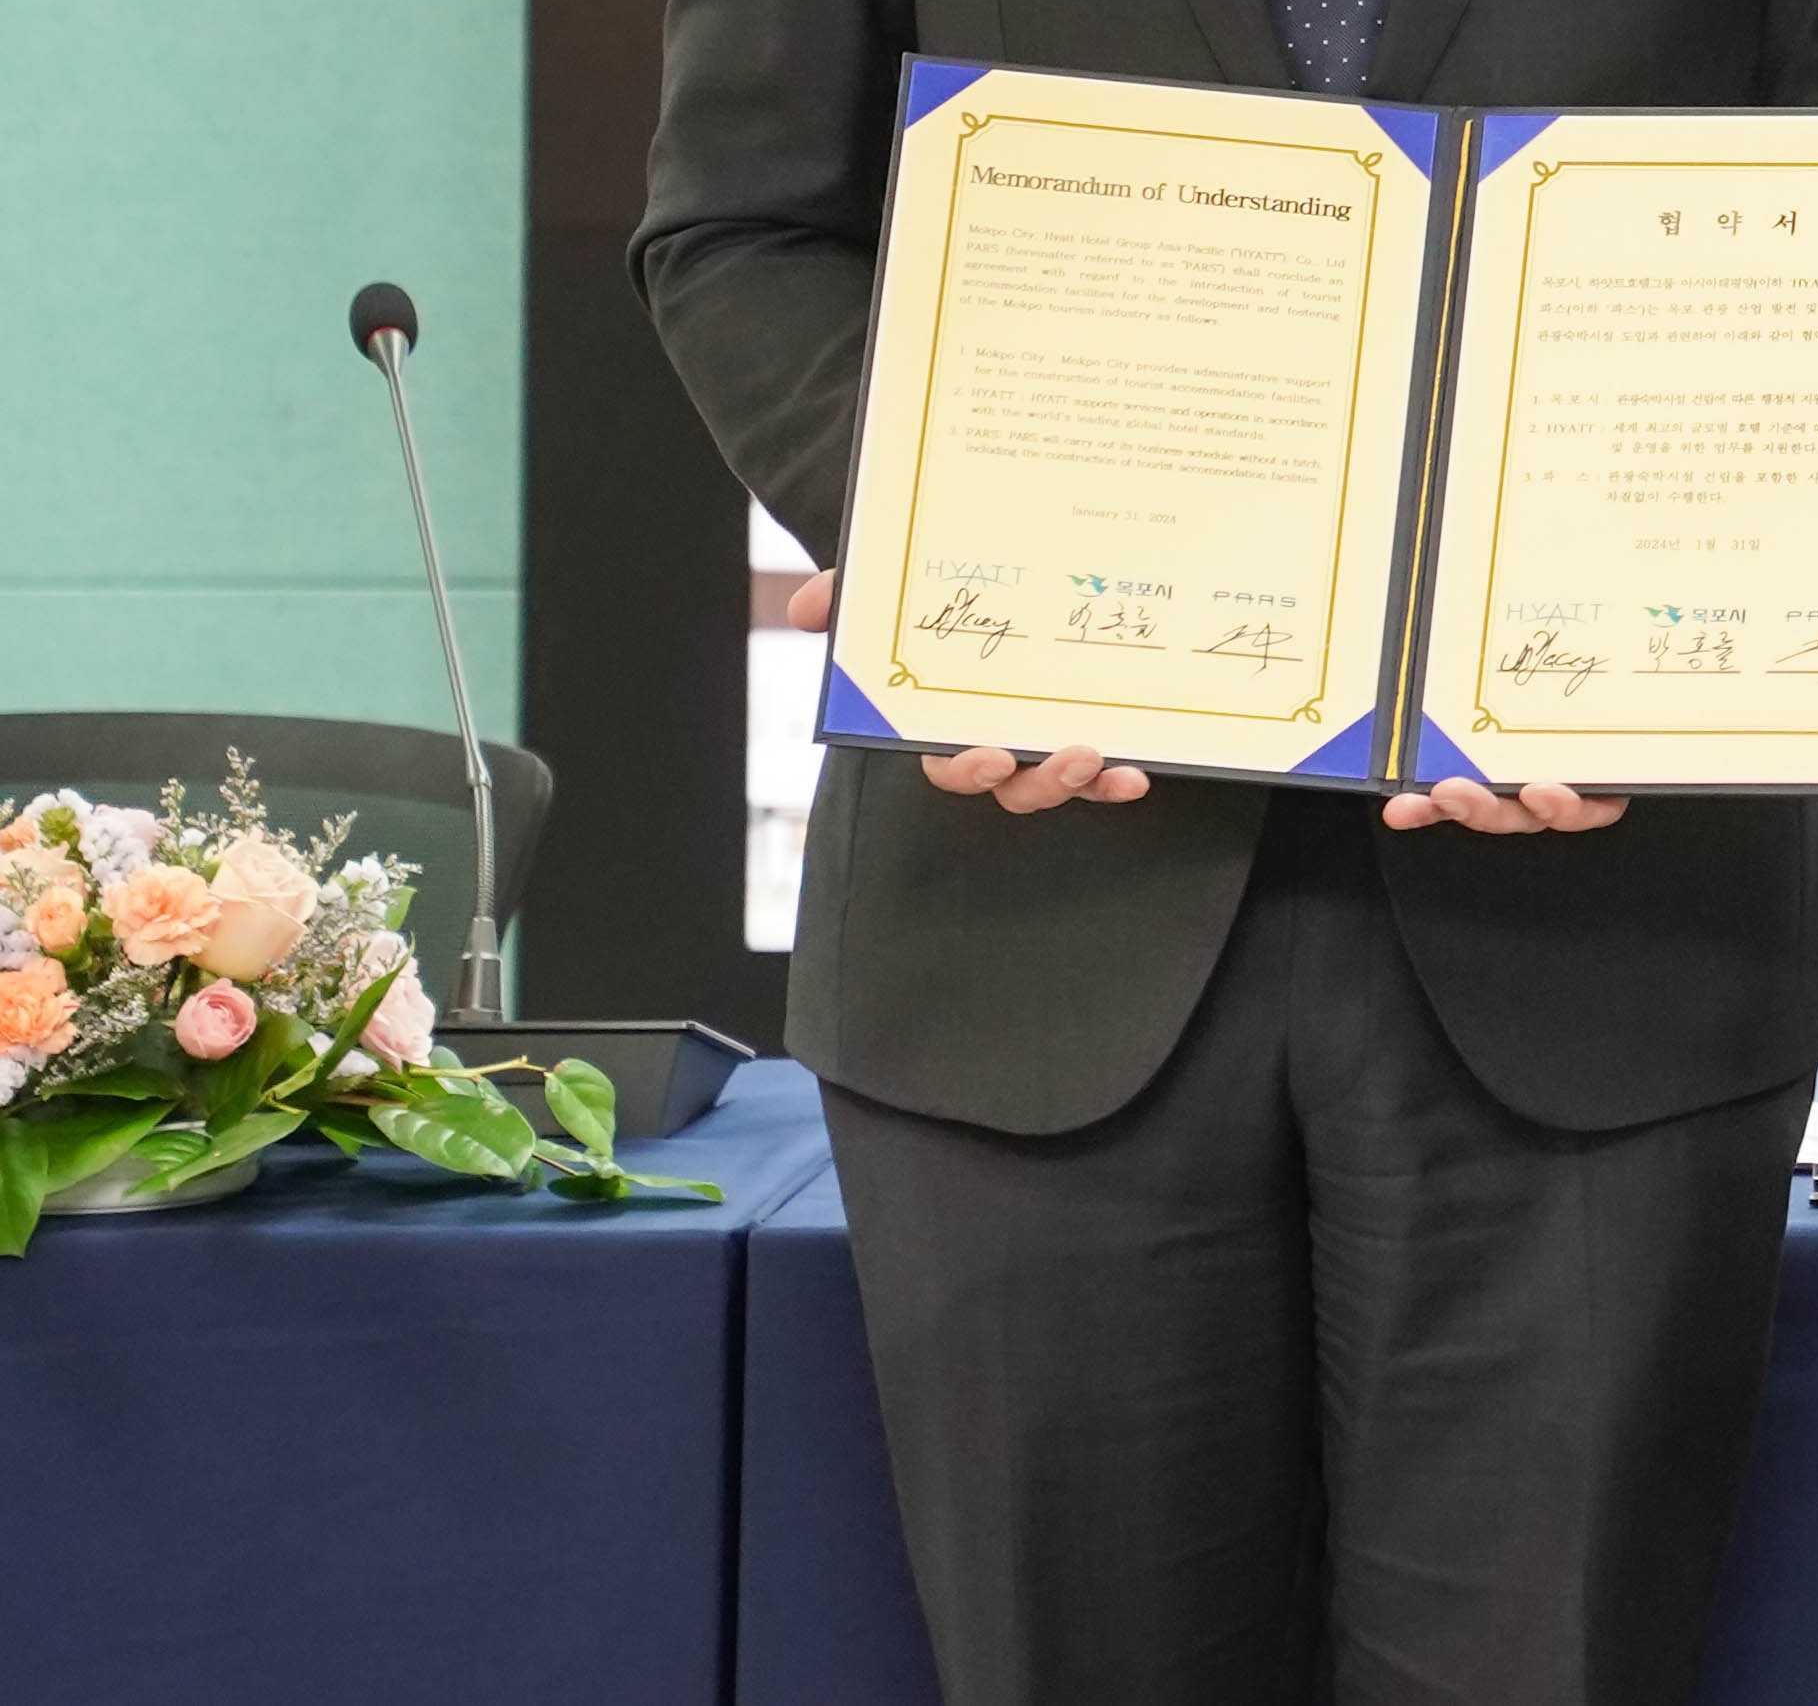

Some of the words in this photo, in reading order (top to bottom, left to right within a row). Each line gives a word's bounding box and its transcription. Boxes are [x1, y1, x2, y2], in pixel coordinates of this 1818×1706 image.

[969, 164, 1132, 199] Memorandum
[1141, 182, 1168, 202] of
[1178, 184, 1353, 223] Understanding
[924, 558, 1027, 587] HYATT
[1115, 580, 1174, 601] 목포시
[1211, 590, 1297, 608] PARS
[1505, 602, 1604, 626] HYATT
[1691, 608, 1747, 625] 목포시
